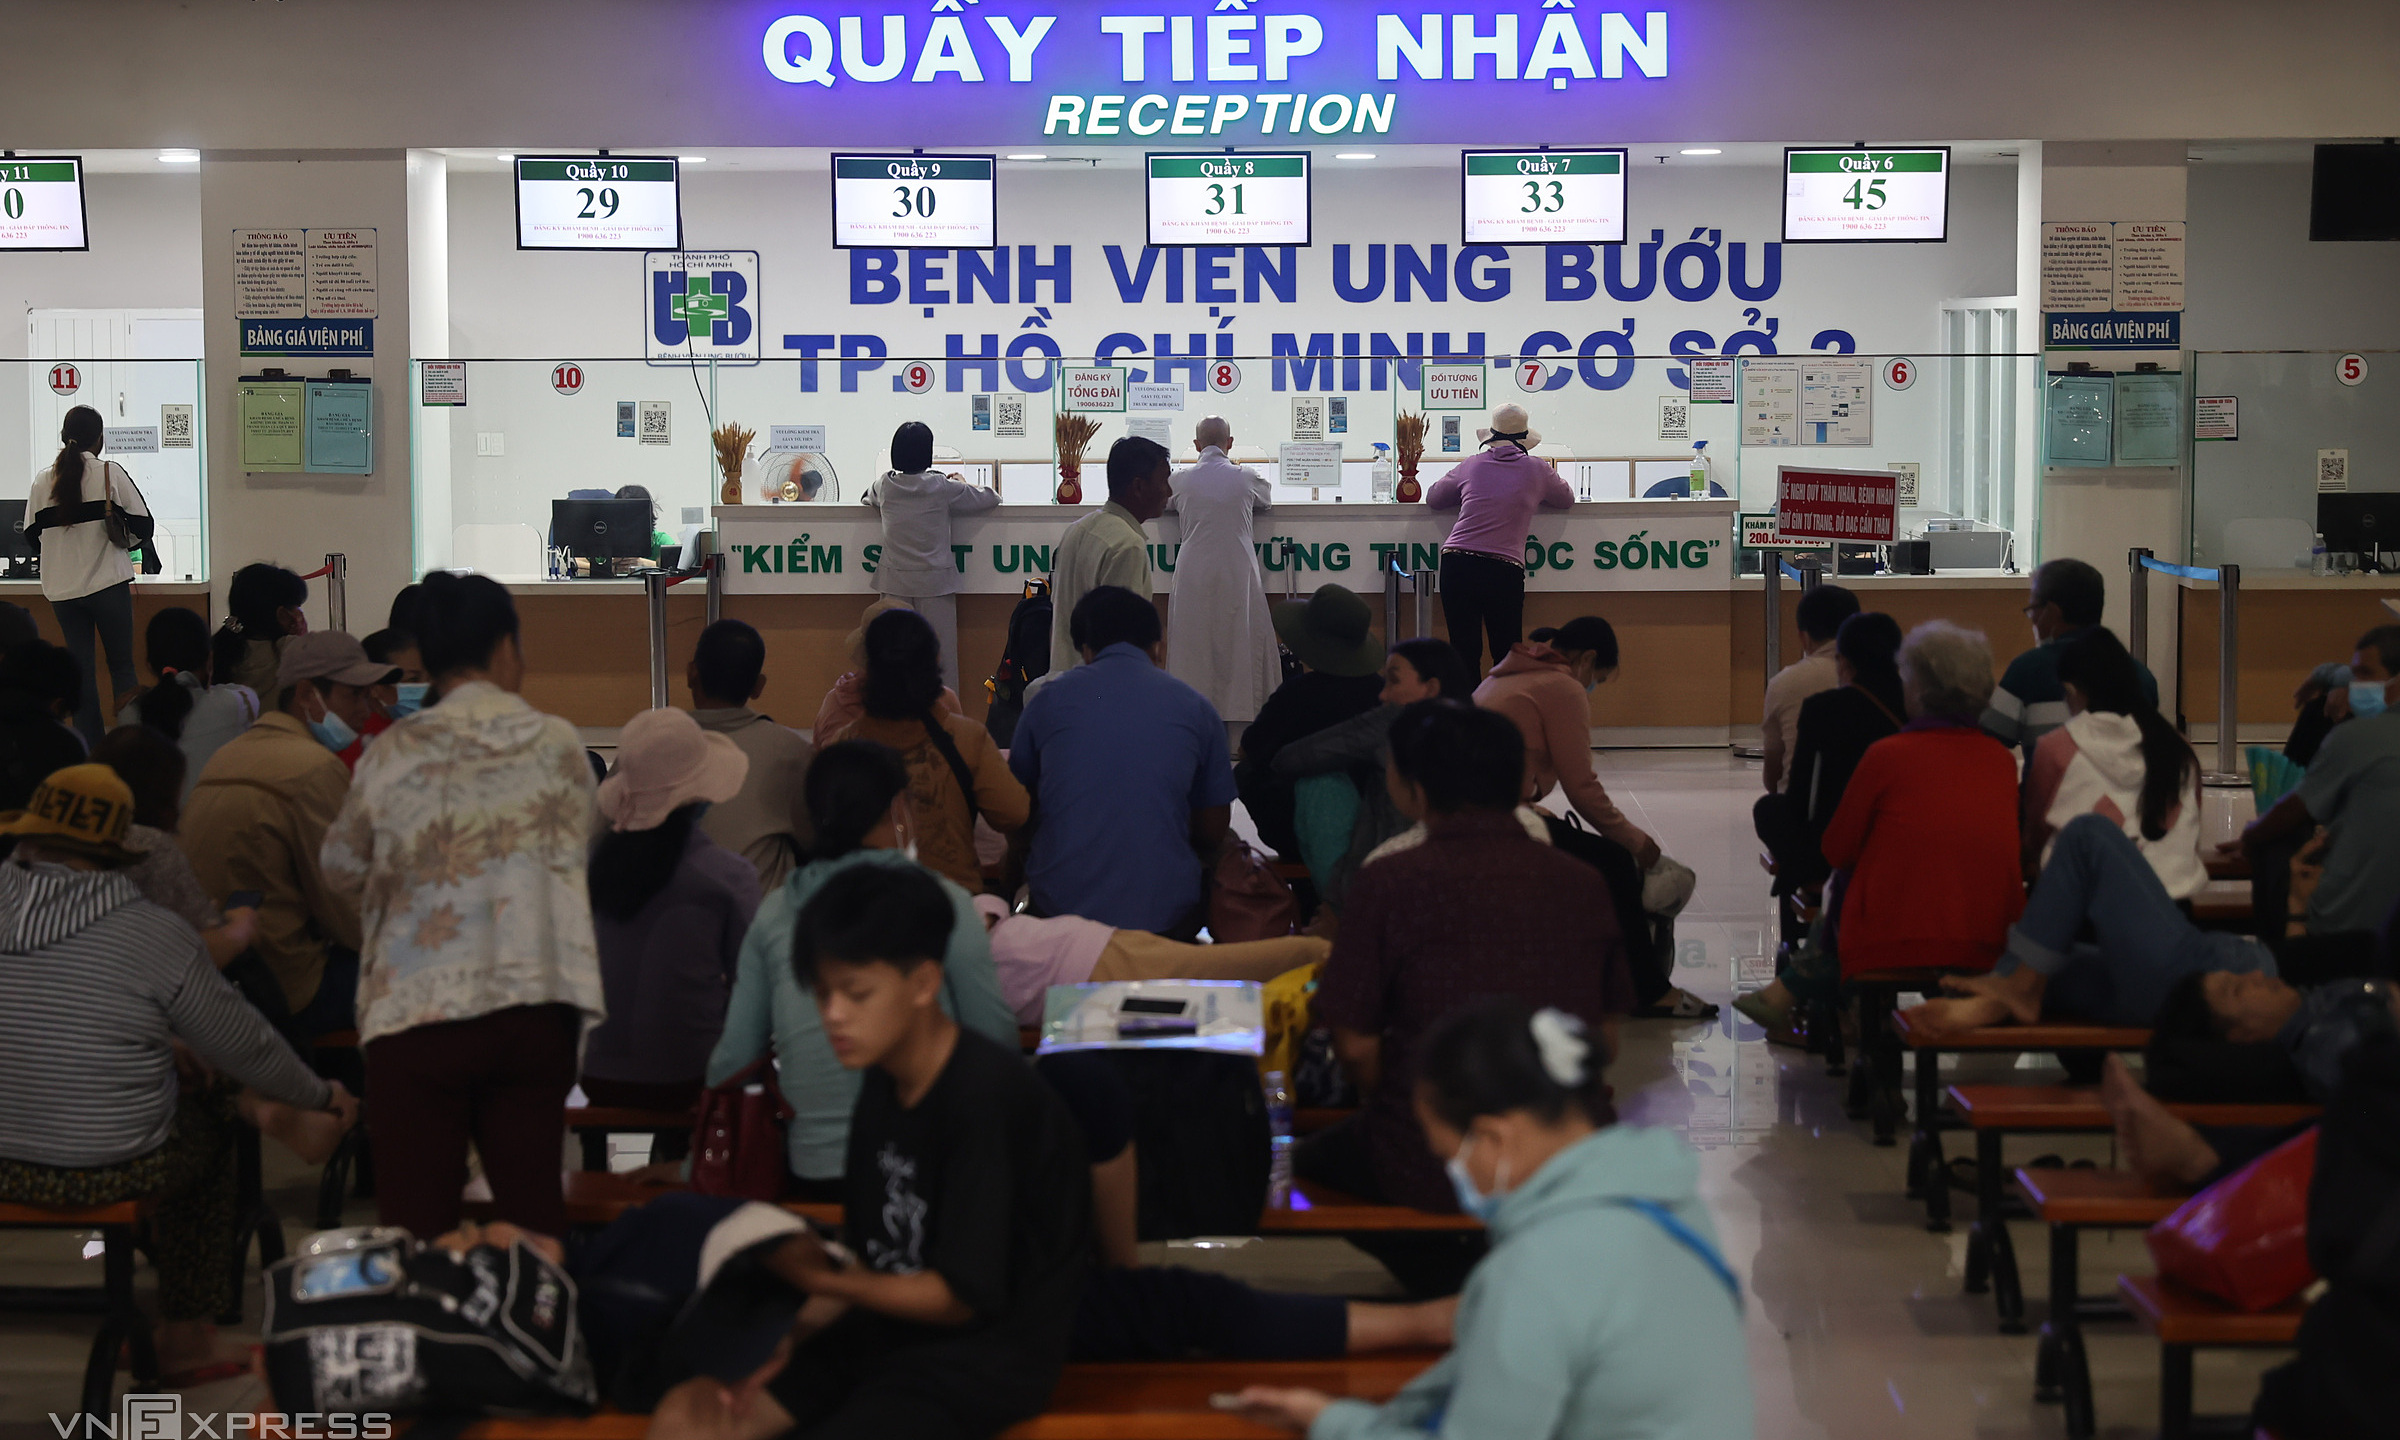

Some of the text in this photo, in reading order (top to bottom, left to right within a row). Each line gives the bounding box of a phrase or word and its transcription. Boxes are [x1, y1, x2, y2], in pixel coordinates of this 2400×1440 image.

[762, 0, 1668, 90] QUẦY TIẾP NHẬN
[1043, 93, 1397, 136] RECEPTION
[13, 165, 30, 180] 11
[565, 161, 628, 181] Quầy 10
[887, 160, 941, 179] Quầy 9
[1200, 158, 1254, 178] Quầy 8
[1516, 155, 1571, 175] Quầy 7
[1838, 153, 1894, 173] Quầy 6
[576, 187, 620, 219] 29
[892, 186, 936, 218] 30
[1205, 183, 1247, 215] 31
[1521, 181, 1564, 213] 33
[1843, 178, 1887, 210] 45
[337, 232, 357, 240] TIÊN
[2081, 225, 2097, 233] BÁO
[2145, 224, 2167, 233] TIÊN
[1332, 243, 1512, 302] UNG
[1545, 227, 1782, 302] BƯỚU
[247, 325, 364, 350] BẢNG GIÁ VIỆN PHÍ
[2052, 319, 2171, 343] BẢNG GIÁ VIỆN PHÍ
[945, 306, 1062, 394] HỒ
[52, 368, 78, 389] 11
[555, 367, 581, 388] 10
[910, 366, 927, 387] 9
[1075, 372, 1111, 381] ĐĂNG KÝ
[1216, 365, 1232, 386] 8
[1431, 372, 1478, 384] ĐỐI TƯỢNG
[1524, 365, 1540, 386] 7
[1891, 363, 1908, 384] 6
[2343, 358, 2361, 380] 5
[1067, 384, 1120, 398] TỔNG ĐÀI
[1430, 387, 1479, 399] ƯU TIÊN
[1790, 483, 1806, 505] NGHỊ
[1820, 481, 1837, 502] THÂN
[1857, 483, 1876, 508] BỆNH
[1875, 484, 1894, 505] NHÂN
[1745, 520, 1767, 530] KHÁM
[1873, 514, 1891, 538] THẬN
[1369, 543, 1439, 571] TIN
